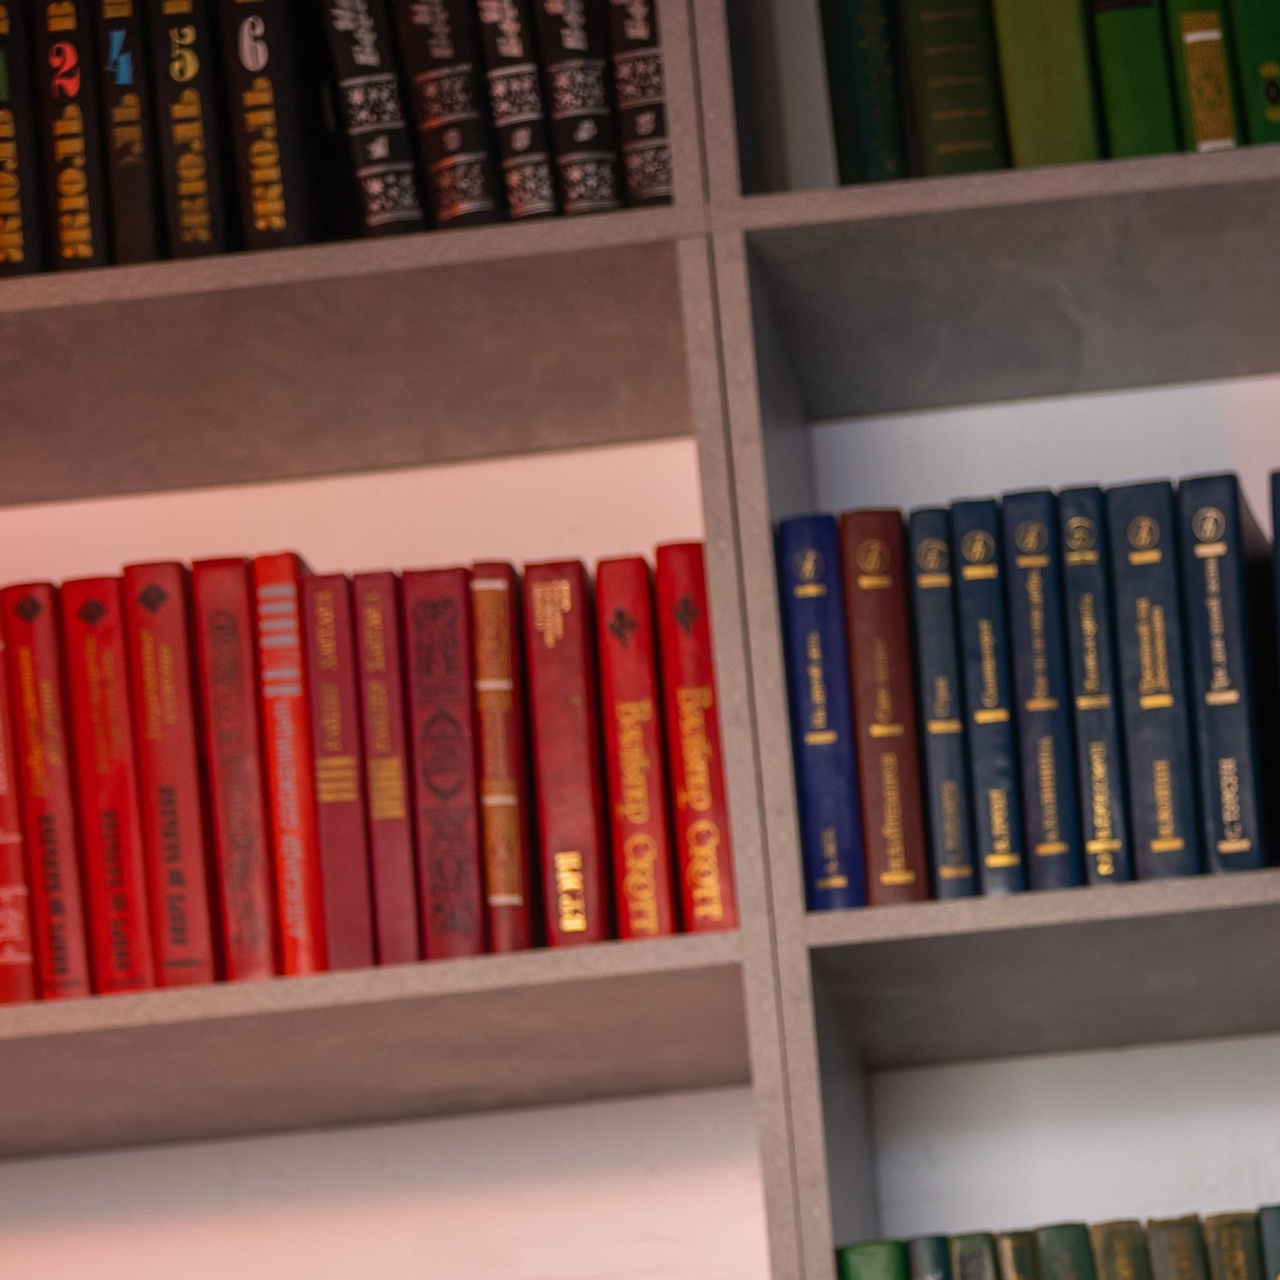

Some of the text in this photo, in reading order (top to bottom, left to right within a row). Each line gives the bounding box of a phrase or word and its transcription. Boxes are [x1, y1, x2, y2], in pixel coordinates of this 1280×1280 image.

[48, 42, 80, 99] 2
[105, 29, 134, 86] 4
[168, 26, 199, 83] 5
[238, 15, 270, 73] 6
